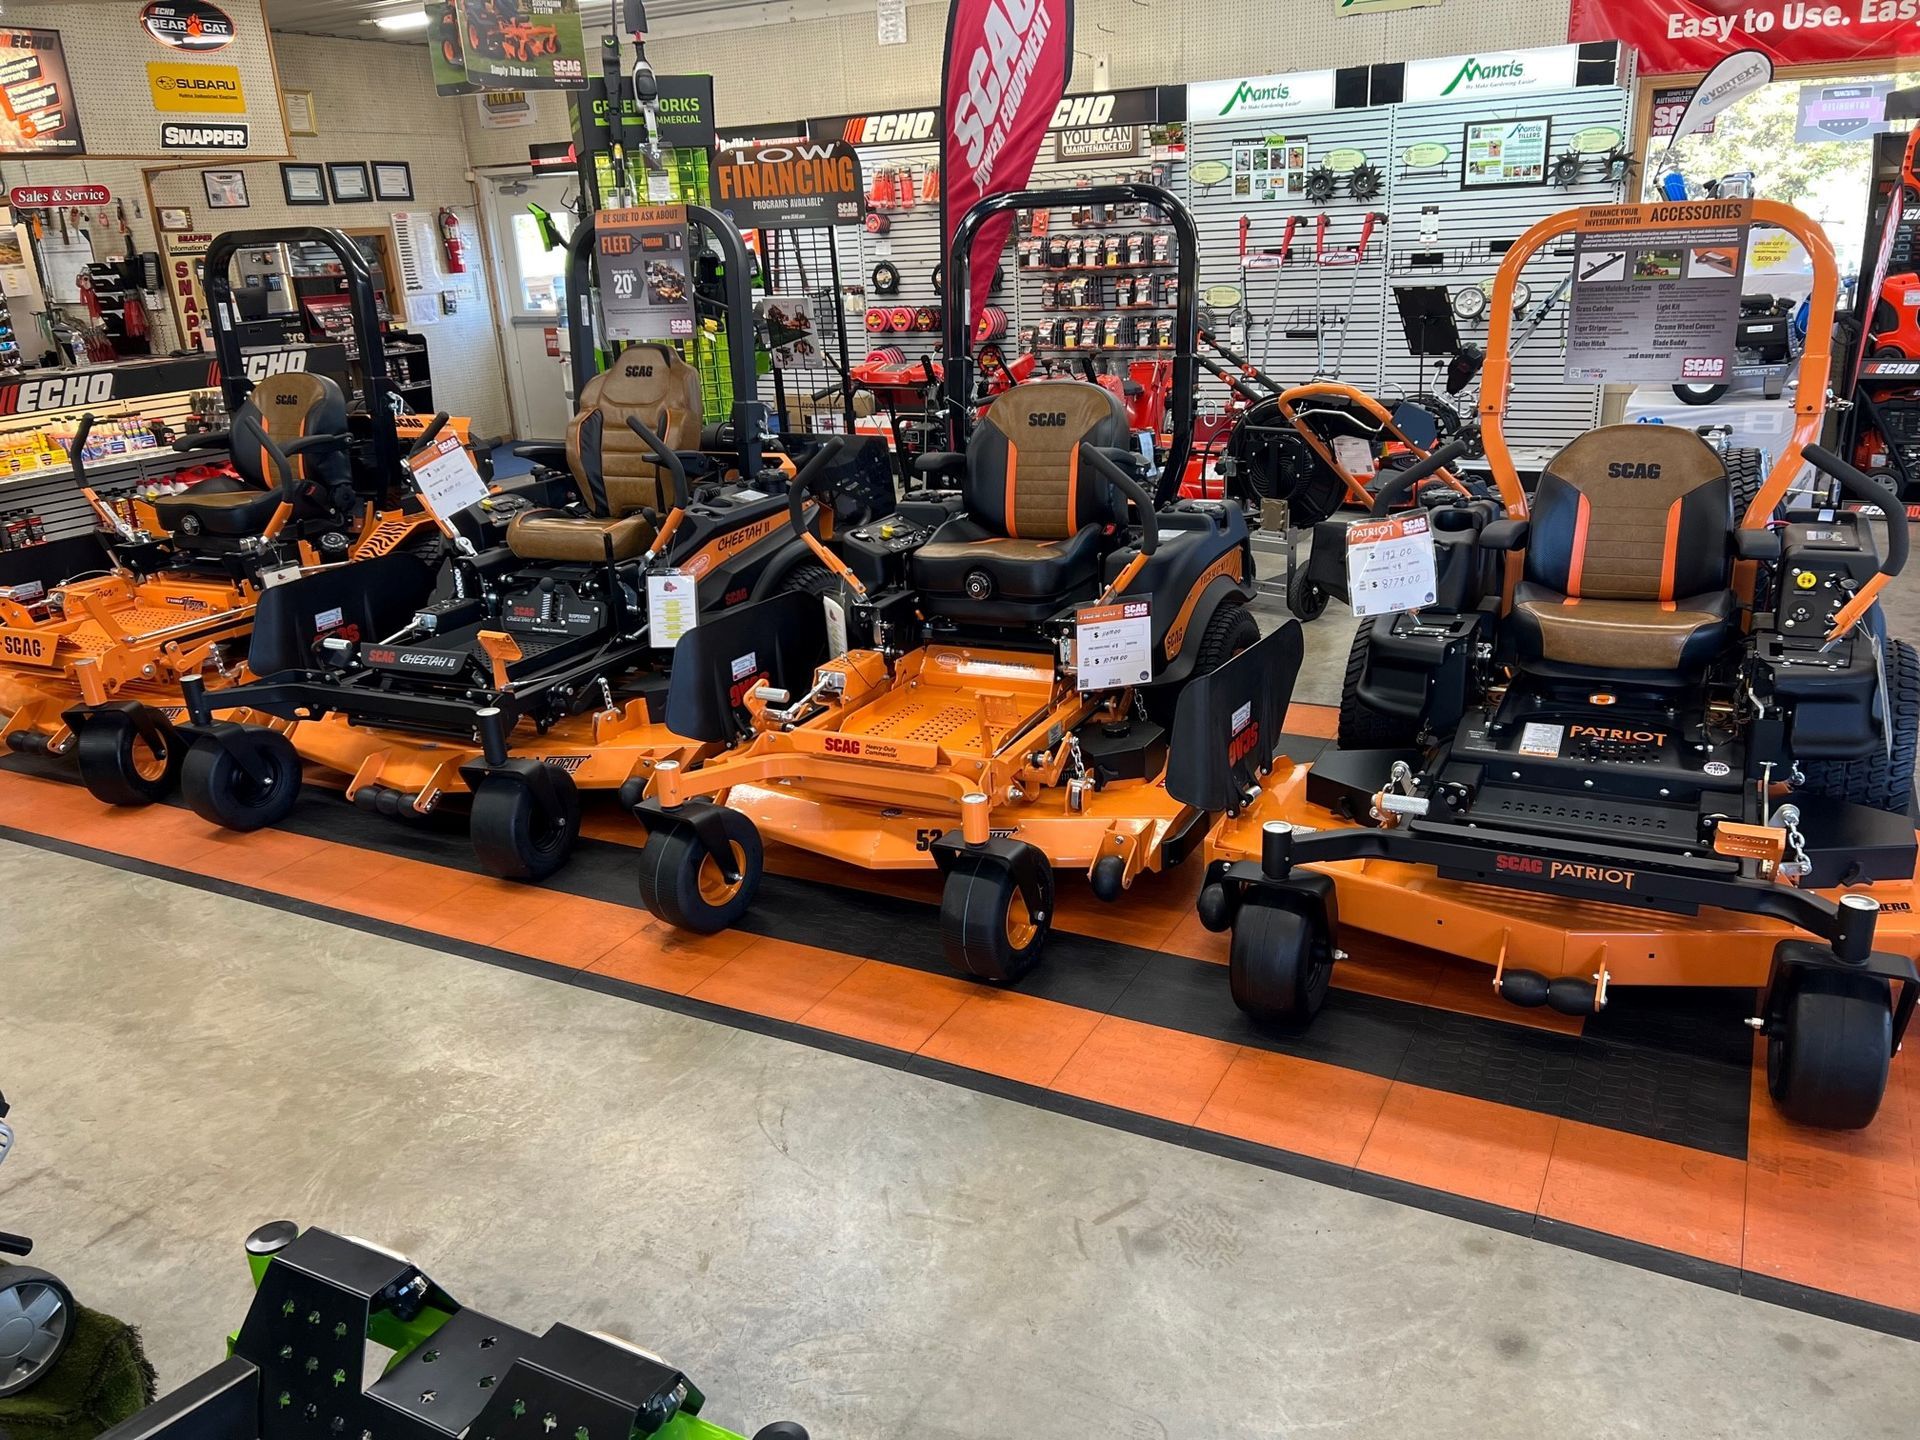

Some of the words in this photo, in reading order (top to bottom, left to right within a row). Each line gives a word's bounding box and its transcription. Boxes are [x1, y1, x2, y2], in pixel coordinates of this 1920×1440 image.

[155, 7, 175, 16] ECHO
[150, 18, 187, 30] BEAR
[203, 23, 227, 34] CAT
[1667, 13, 1737, 43] Easy
[1744, 8, 1774, 33] to
[1783, 3, 1850, 30] Use.
[11, 34, 54, 50] ECHO
[490, 64, 509, 77] Simply
[509, 66, 521, 76] The
[553, 60, 581, 72] SCAG
[1000, 0, 1051, 133] EQUIPMENT
[176, 78, 236, 90] SUBARU
[1440, 57, 1523, 96] Mantis
[1708, 63, 1760, 98] VORTEXX
[1218, 81, 1290, 116] Mantis
[656, 115, 701, 124] MMERCIAL
[1048, 95, 1116, 128] CHO
[861, 111, 936, 143] ECHO
[165, 126, 246, 146] SNAPPER
[1064, 130, 1091, 145] YOU
[1103, 127, 1130, 141] CAN
[735, 144, 835, 165] LOW
[1066, 143, 1118, 155] MAINTENANCE
[1118, 142, 1130, 150] KIT
[718, 156, 855, 200] FINANCING
[18, 190, 49, 203] Sales
[52, 189, 62, 201] &
[65, 188, 105, 201] Service
[753, 199, 789, 210] PROGRAMS
[837, 202, 858, 213] SCAG
[603, 214, 611, 224] BE
[613, 212, 629, 223] SURE
[631, 211, 640, 221] TO
[641, 210, 654, 221] ASK
[656, 209, 679, 220] ABOUT
[1584, 217, 1624, 227] INVESTMENT
[1625, 216, 1641, 226] WITH
[1590, 209, 1620, 218] ENHANCE
[1620, 207, 1639, 216] YOUR
[1650, 204, 1743, 223] ACCESSORIES
[601, 235, 632, 254] FLEET
[670, 320, 692, 330] SCAG
[625, 365, 653, 378] SCAG
[1684, 358, 1723, 371] SCAG
[1875, 363, 1919, 374] ECHO
[17, 371, 114, 414] ECHO
[275, 395, 298, 405] SCAG
[1028, 411, 1067, 428] SCAG
[437, 437, 459, 452] SCAG
[1608, 461, 1661, 479] SCAG
[718, 523, 762, 551] CHEETAH
[1351, 524, 1394, 542] PATRIOT
[1402, 517, 1426, 531] SCAG
[1124, 603, 1148, 614] SCAG
[5, 635, 42, 657] SCAG
[368, 650, 396, 663] SCAG
[399, 653, 446, 667] CHEETAH
[1569, 724, 1668, 747] PATRIOT
[825, 737, 860, 755] SCAG
[864, 749, 898, 758] Commercial
[916, 828, 943, 852] 52
[1496, 854, 1543, 874] SCAG
[1550, 861, 1636, 890] PATRIOT
